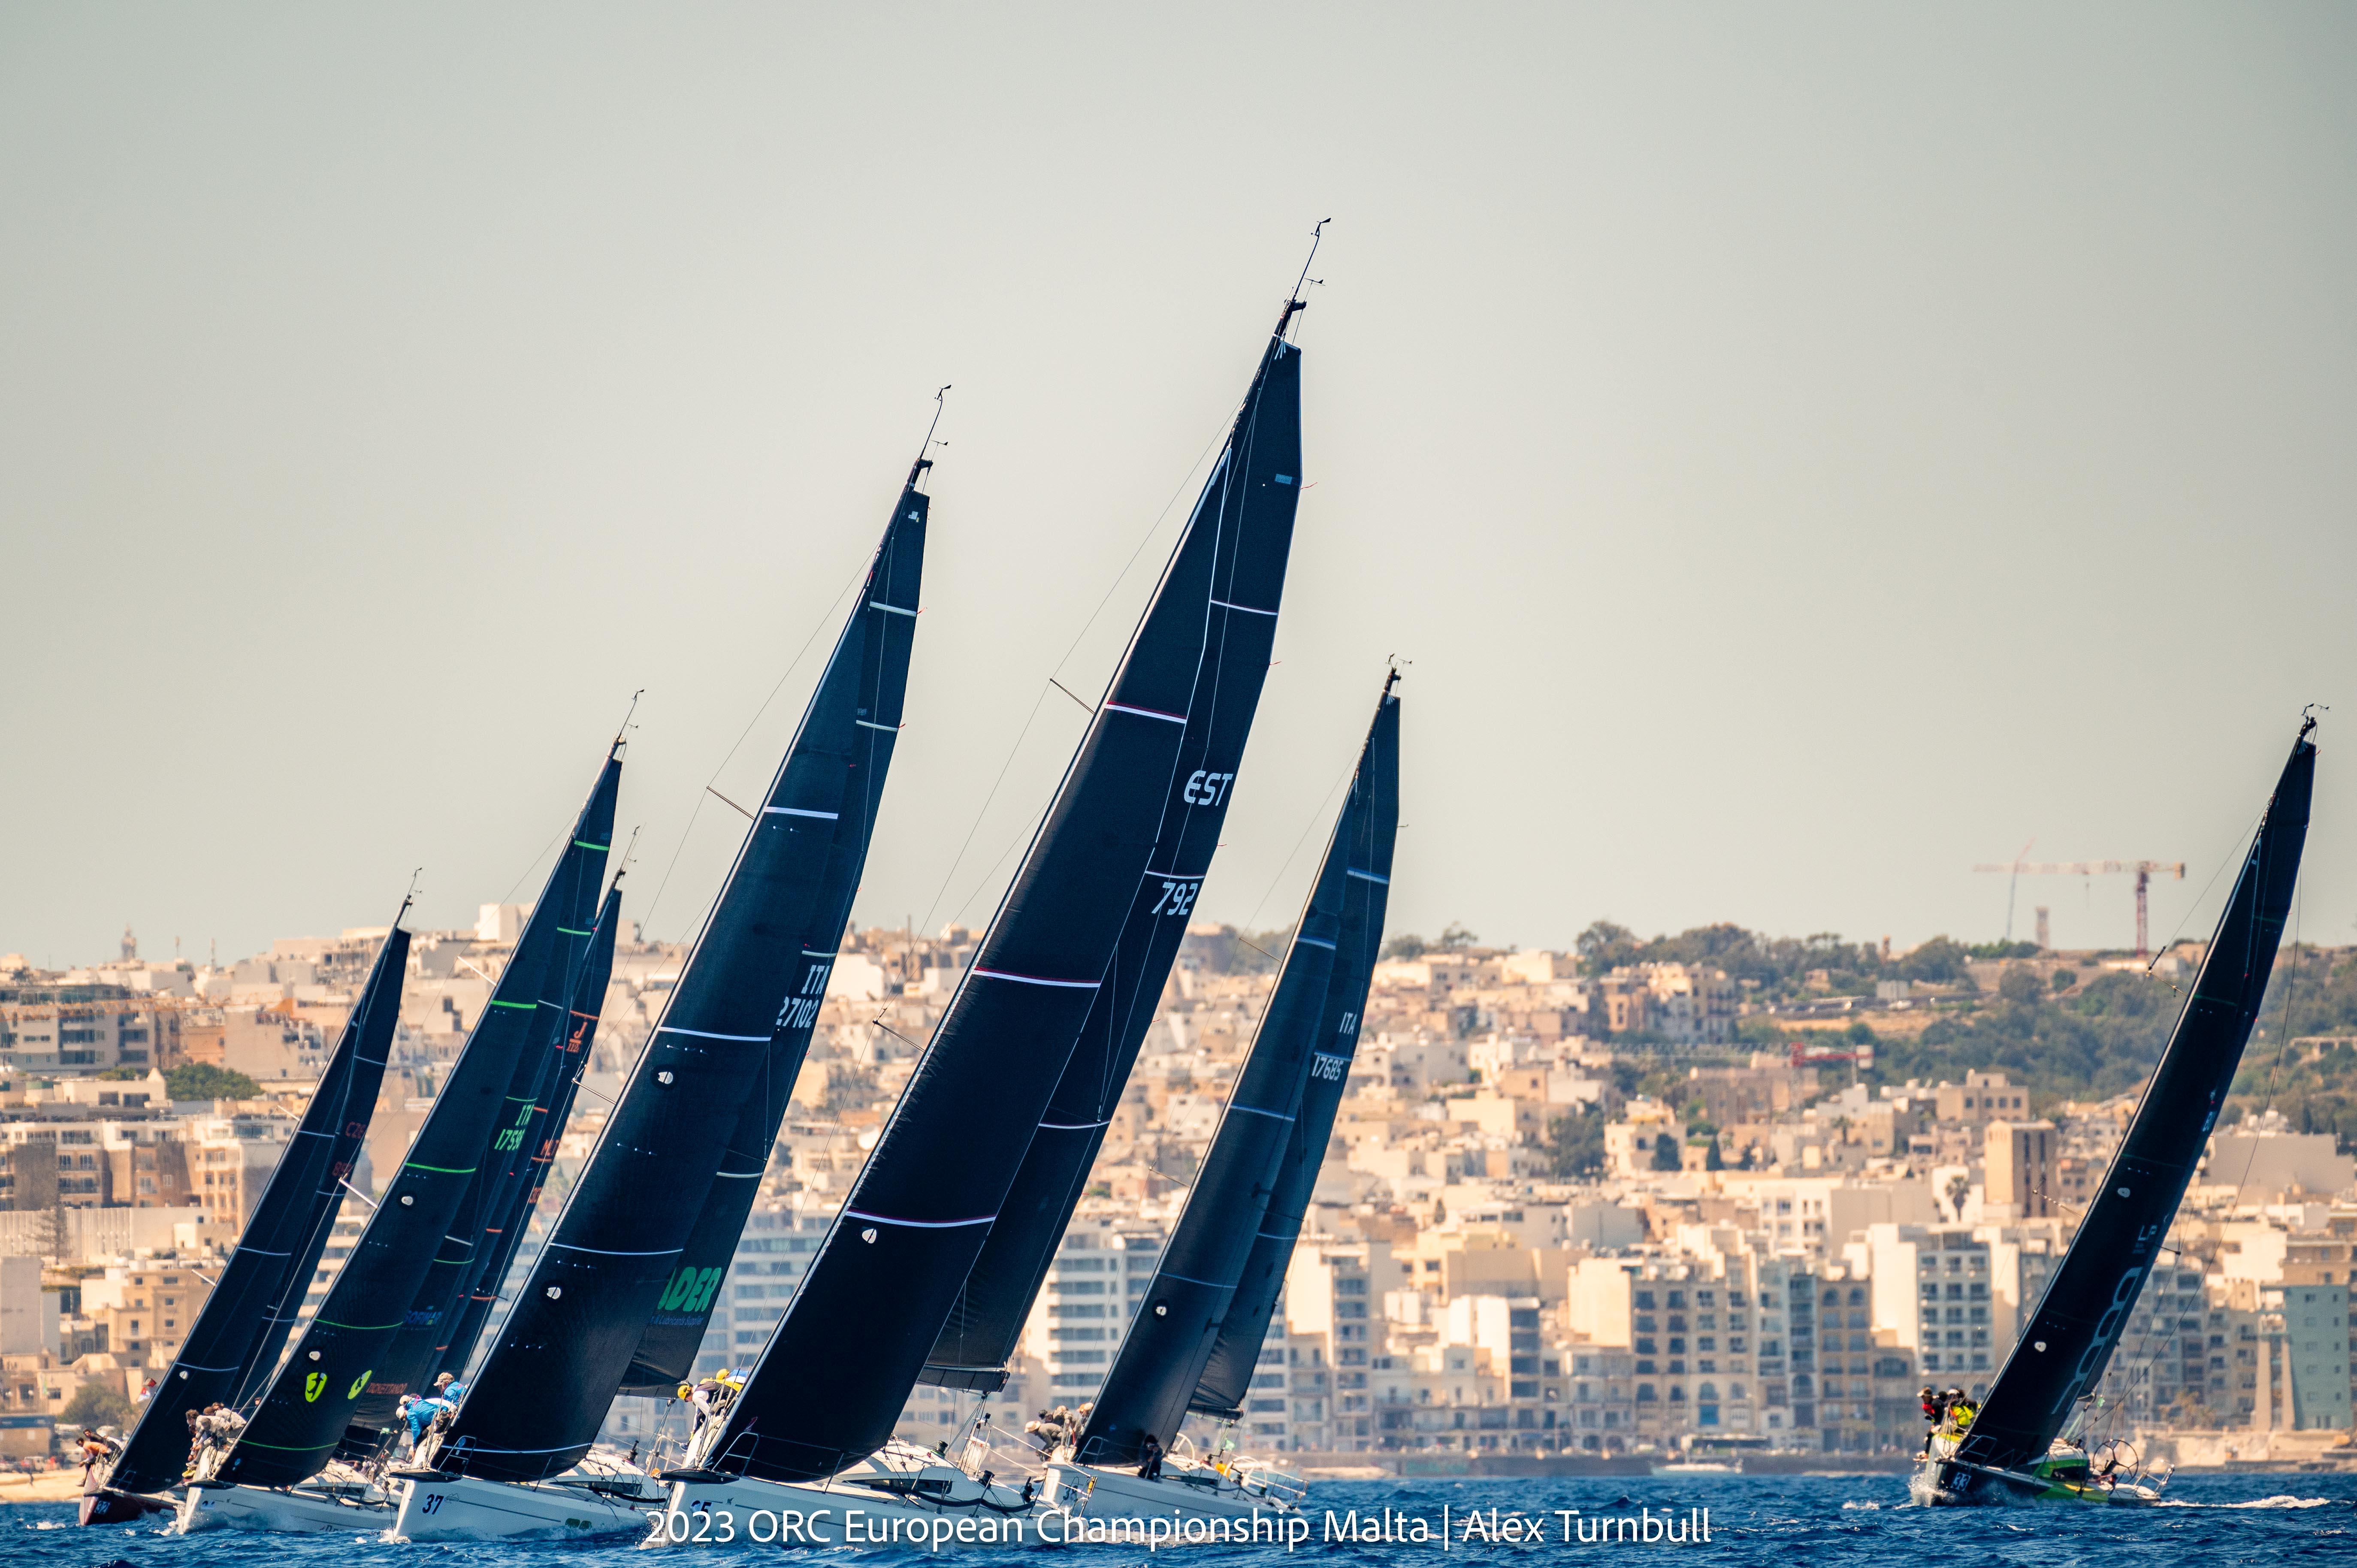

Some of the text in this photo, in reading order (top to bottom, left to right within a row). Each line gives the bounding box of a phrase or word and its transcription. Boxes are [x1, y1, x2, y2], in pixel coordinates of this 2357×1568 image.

[1184, 770, 1233, 806] EST
[1151, 882, 1198, 915] 792
[801, 964, 830, 994] ITA
[1339, 1012, 1357, 1034] ITA
[1311, 1055, 1344, 1081] 17685
[515, 1103, 535, 1126] ITA
[1953, 1474, 1969, 1490] 33
[422, 1493, 444, 1515] 37
